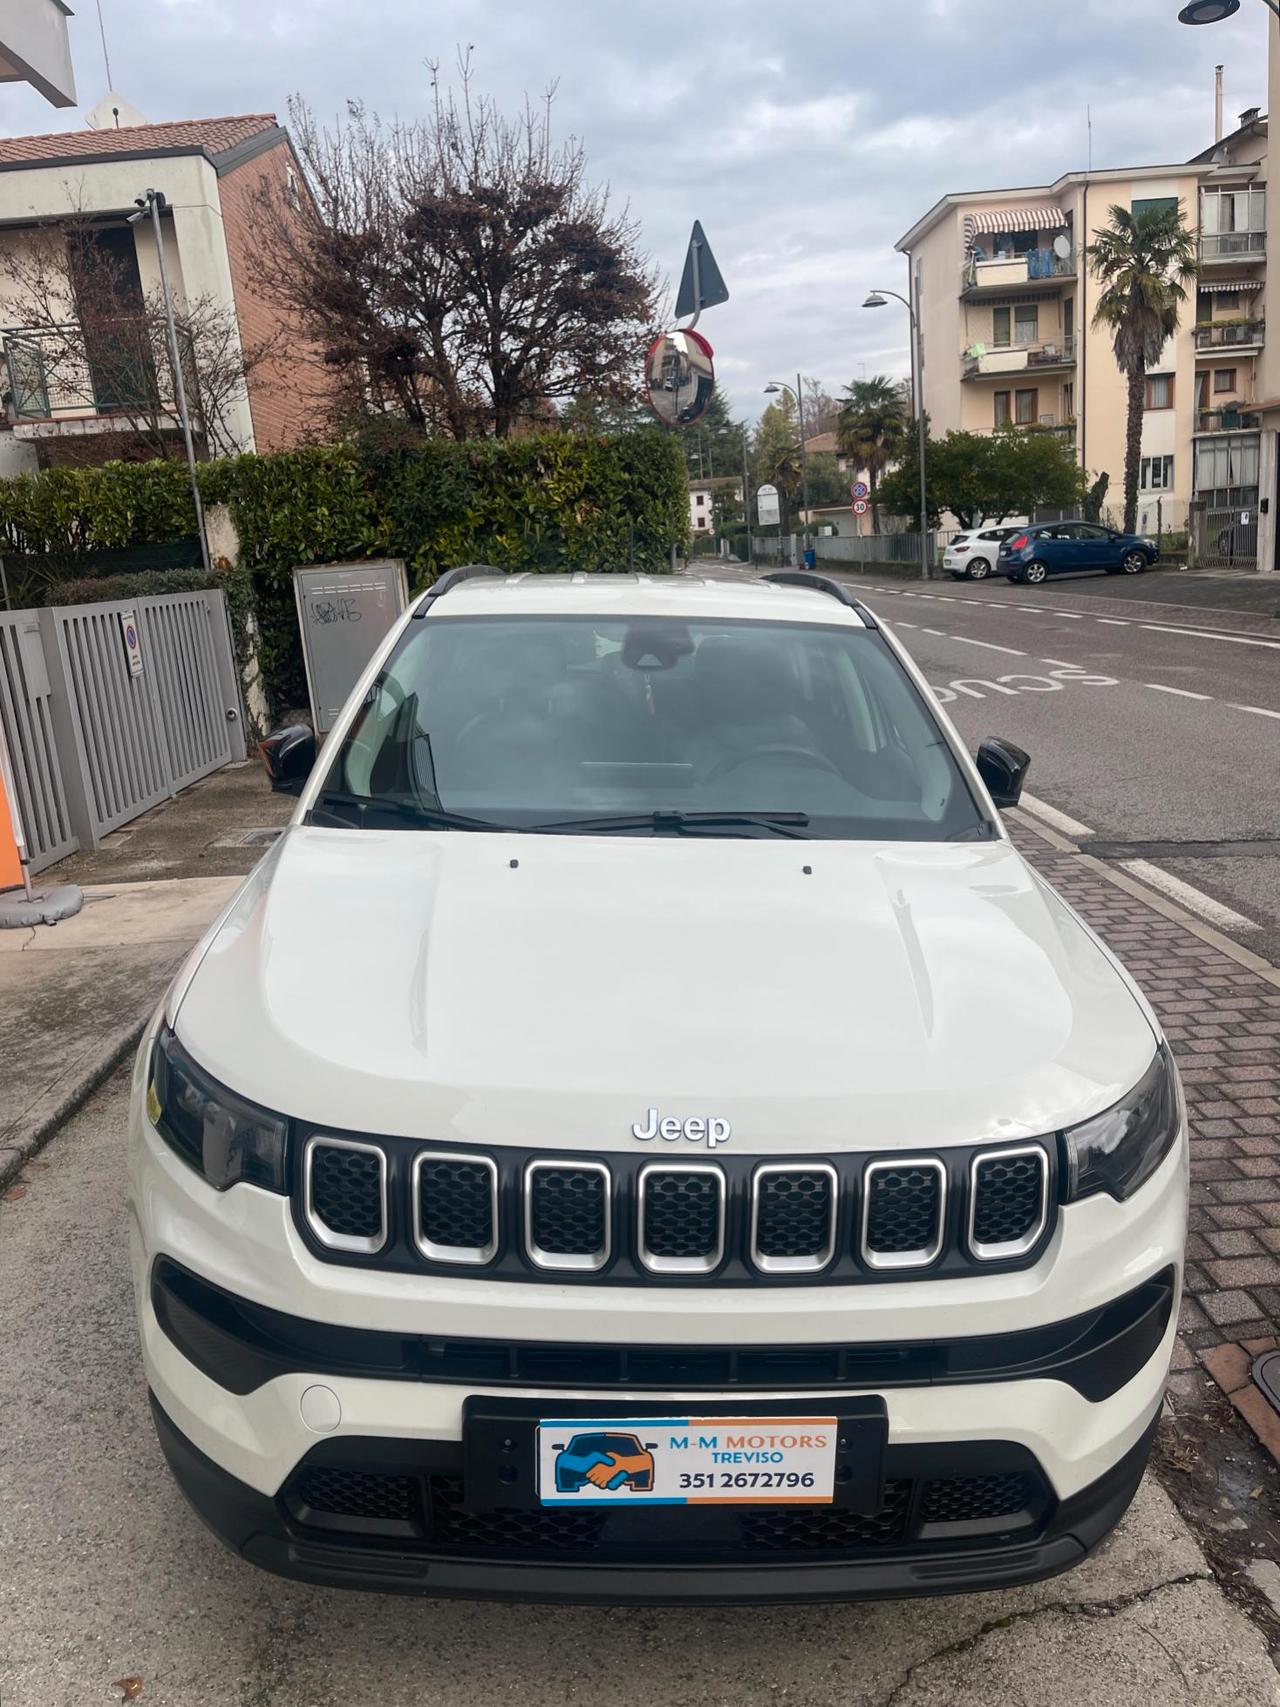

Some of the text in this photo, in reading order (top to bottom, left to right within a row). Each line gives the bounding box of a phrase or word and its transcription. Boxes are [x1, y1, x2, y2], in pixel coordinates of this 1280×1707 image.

[855, 503, 865, 512] 30
[631, 1107, 731, 1149] Jeep
[670, 1435, 827, 1449] M-M MOTORS
[711, 1451, 783, 1464] TREVISO
[679, 1472, 815, 1488] 351 2672796
